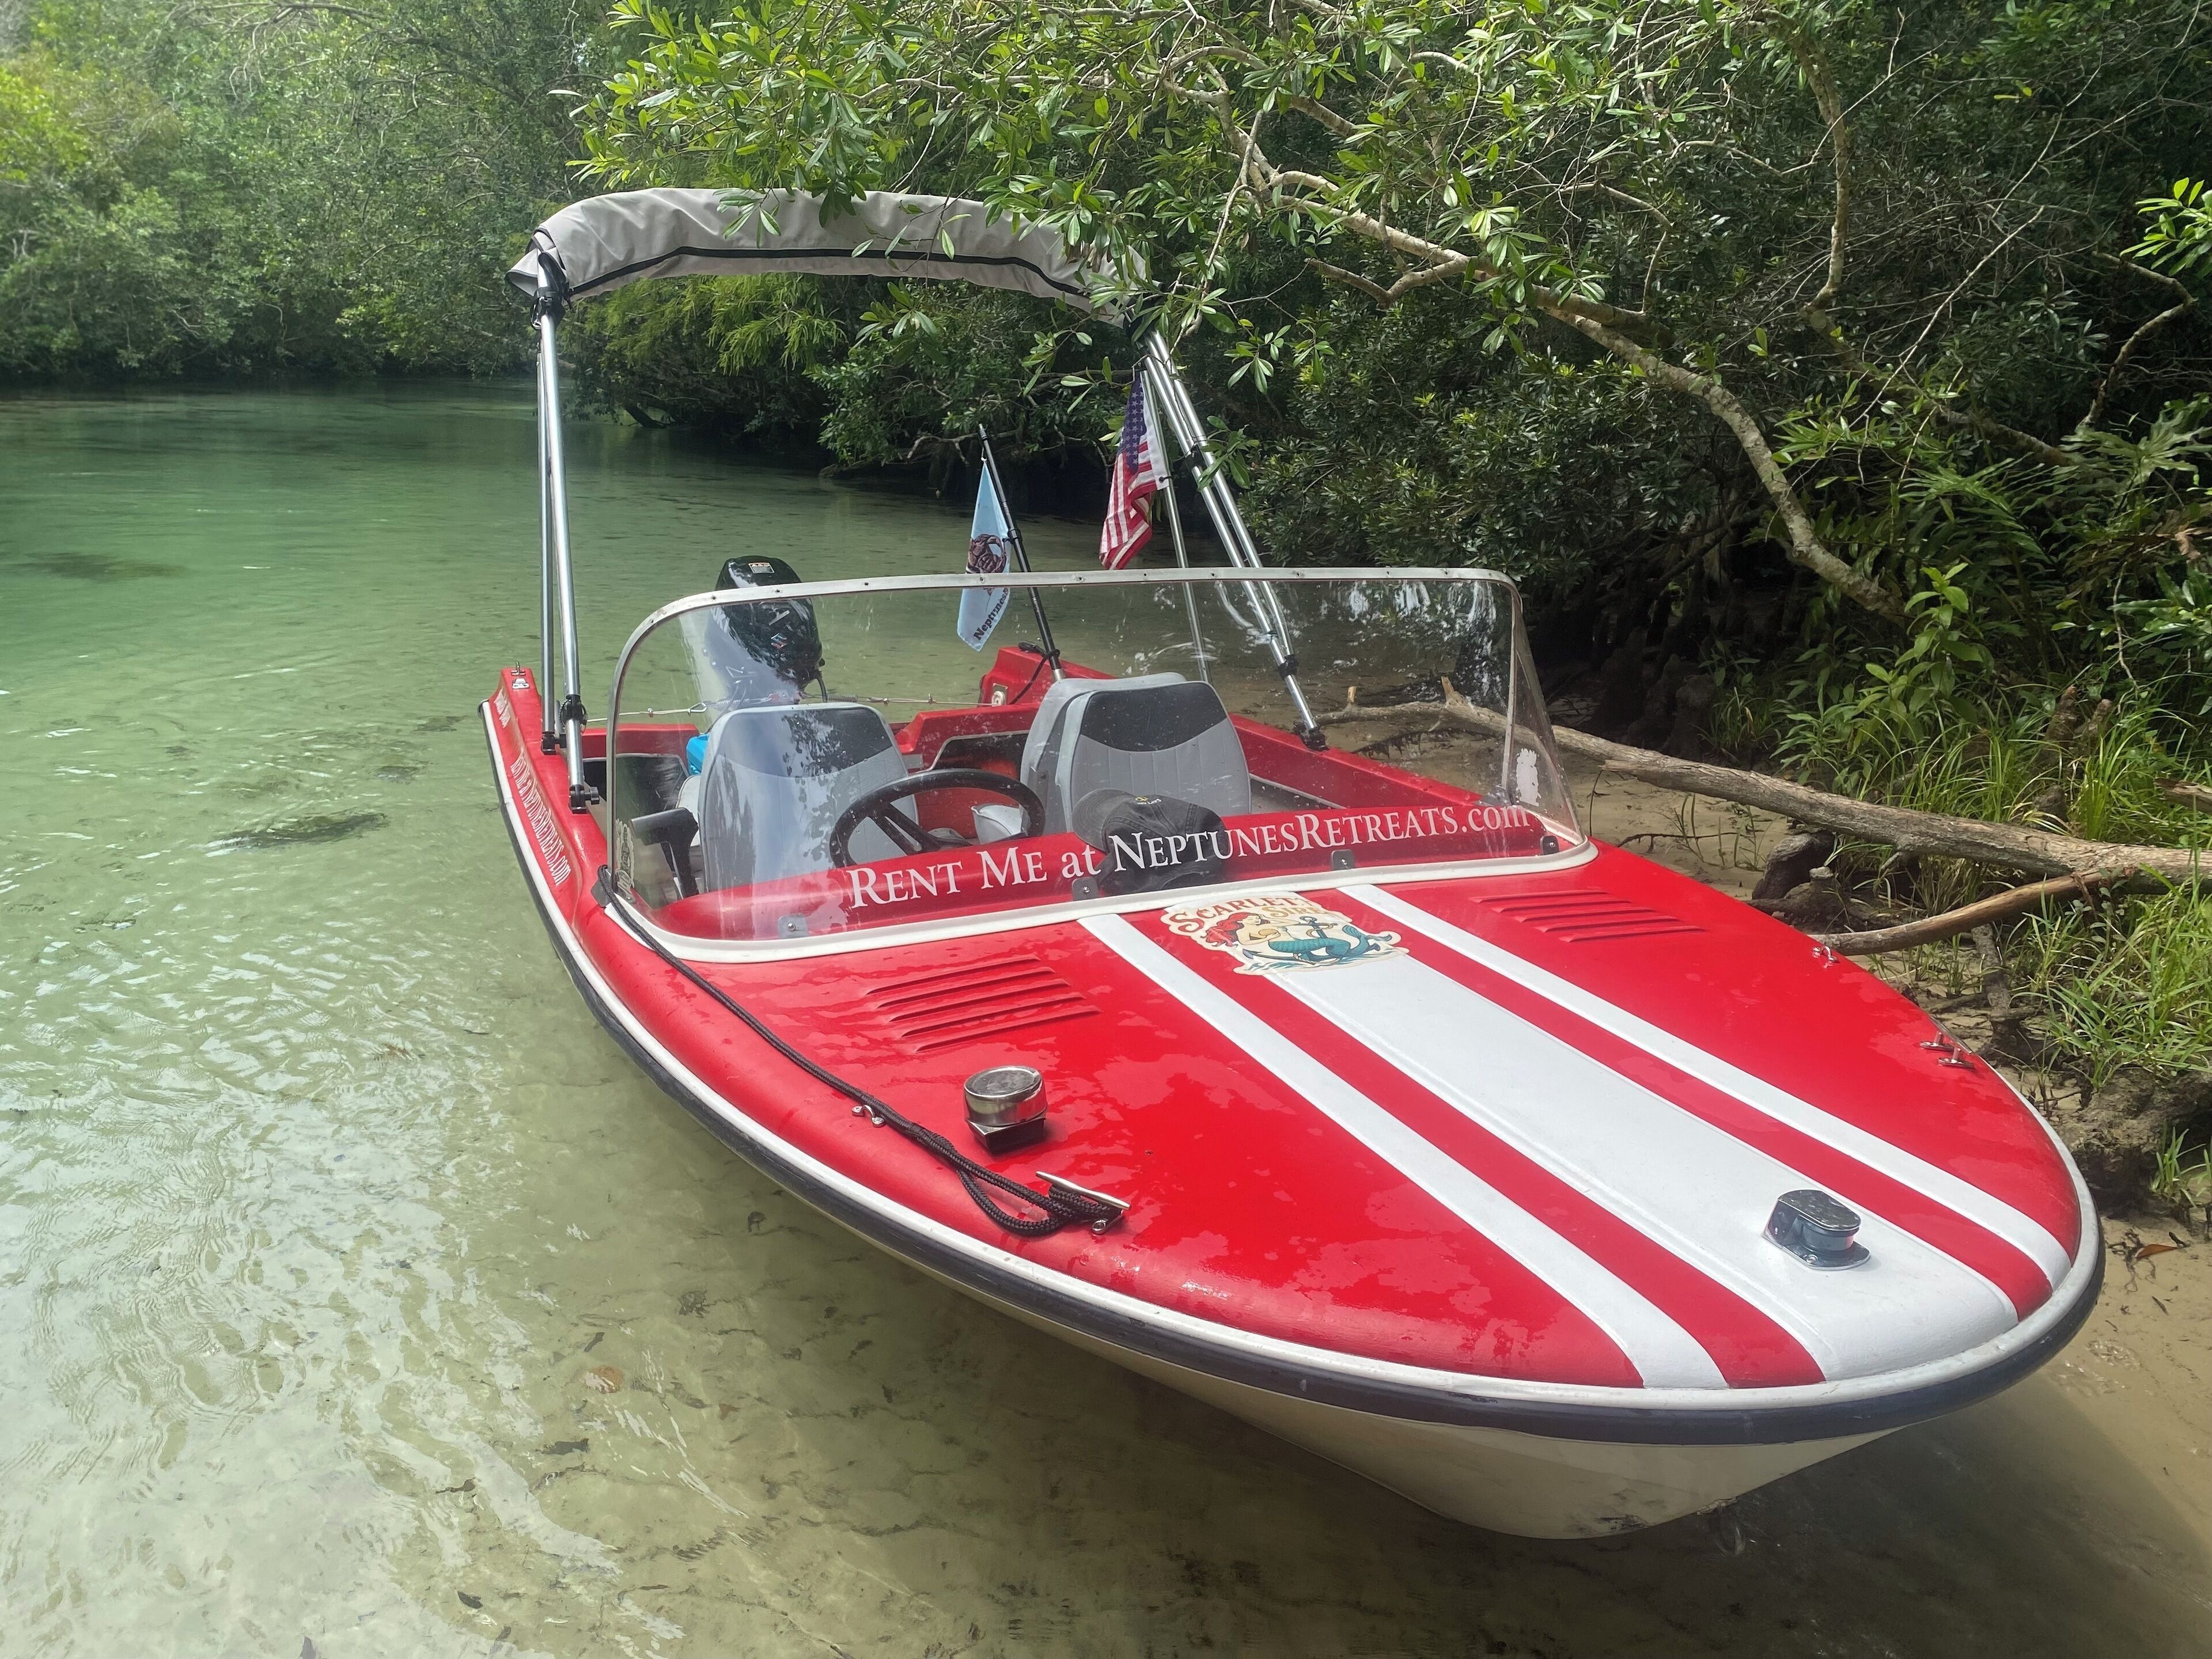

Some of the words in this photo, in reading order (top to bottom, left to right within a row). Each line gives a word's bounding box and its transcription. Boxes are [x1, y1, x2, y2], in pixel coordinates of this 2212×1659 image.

[846, 861, 964, 908] RENT
[976, 846, 1047, 889] ME
[1061, 844, 1101, 879] at
[1261, 906, 1334, 918] SIRE
